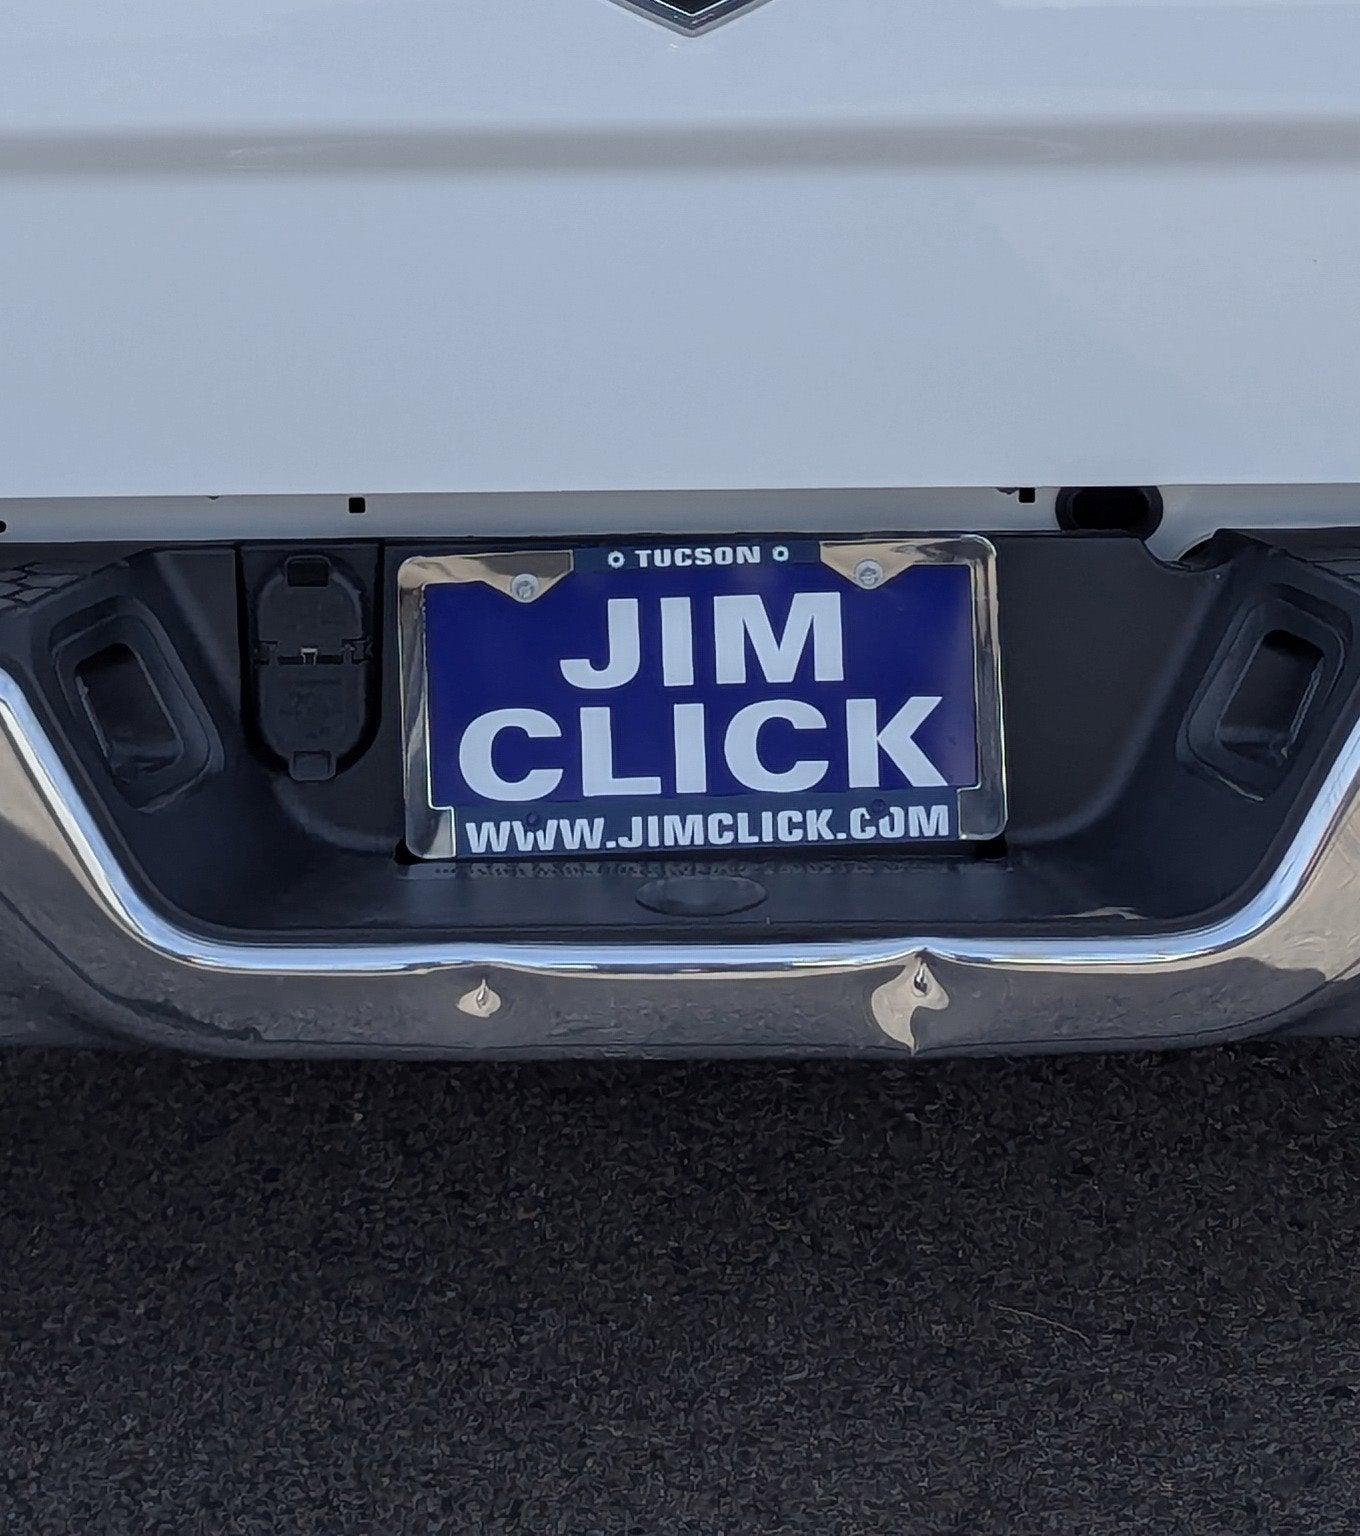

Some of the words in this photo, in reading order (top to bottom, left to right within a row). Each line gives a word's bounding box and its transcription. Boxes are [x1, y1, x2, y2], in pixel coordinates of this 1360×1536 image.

[634, 546, 761, 568] TUCSON
[559, 591, 844, 690] JIM
[458, 696, 949, 802] CLICK
[465, 804, 950, 854] WWW.JIMCLICK.COM
